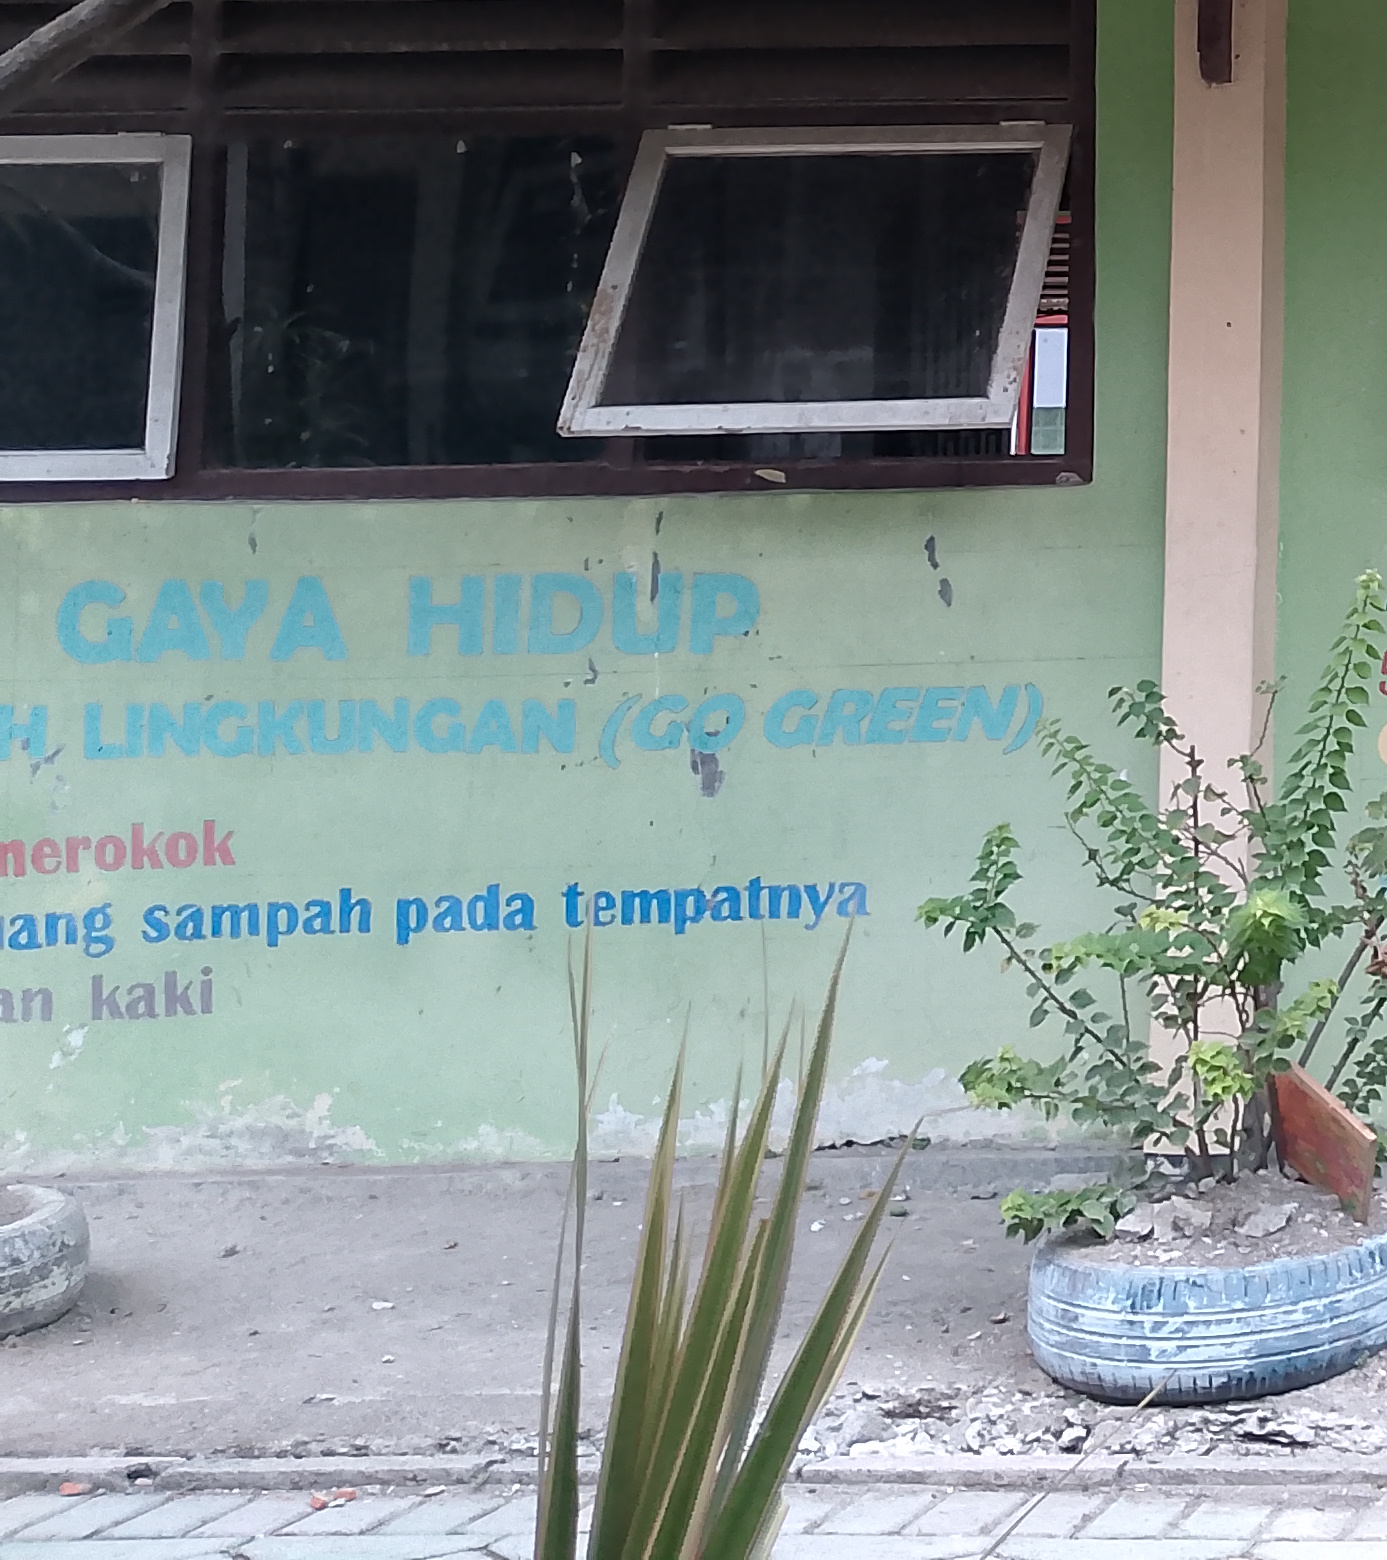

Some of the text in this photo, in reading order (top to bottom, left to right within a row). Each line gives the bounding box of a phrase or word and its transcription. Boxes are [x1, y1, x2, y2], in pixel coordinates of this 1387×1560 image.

[56, 572, 760, 663] GAYA HIDUP
[83, 698, 576, 760] LINGKUNGAN
[599, 693, 745, 769] (GO
[763, 682, 1043, 755] GREEN)
[0, 876, 871, 959] ang sampah pada tempatnya
[91, 966, 214, 1021] kaki
